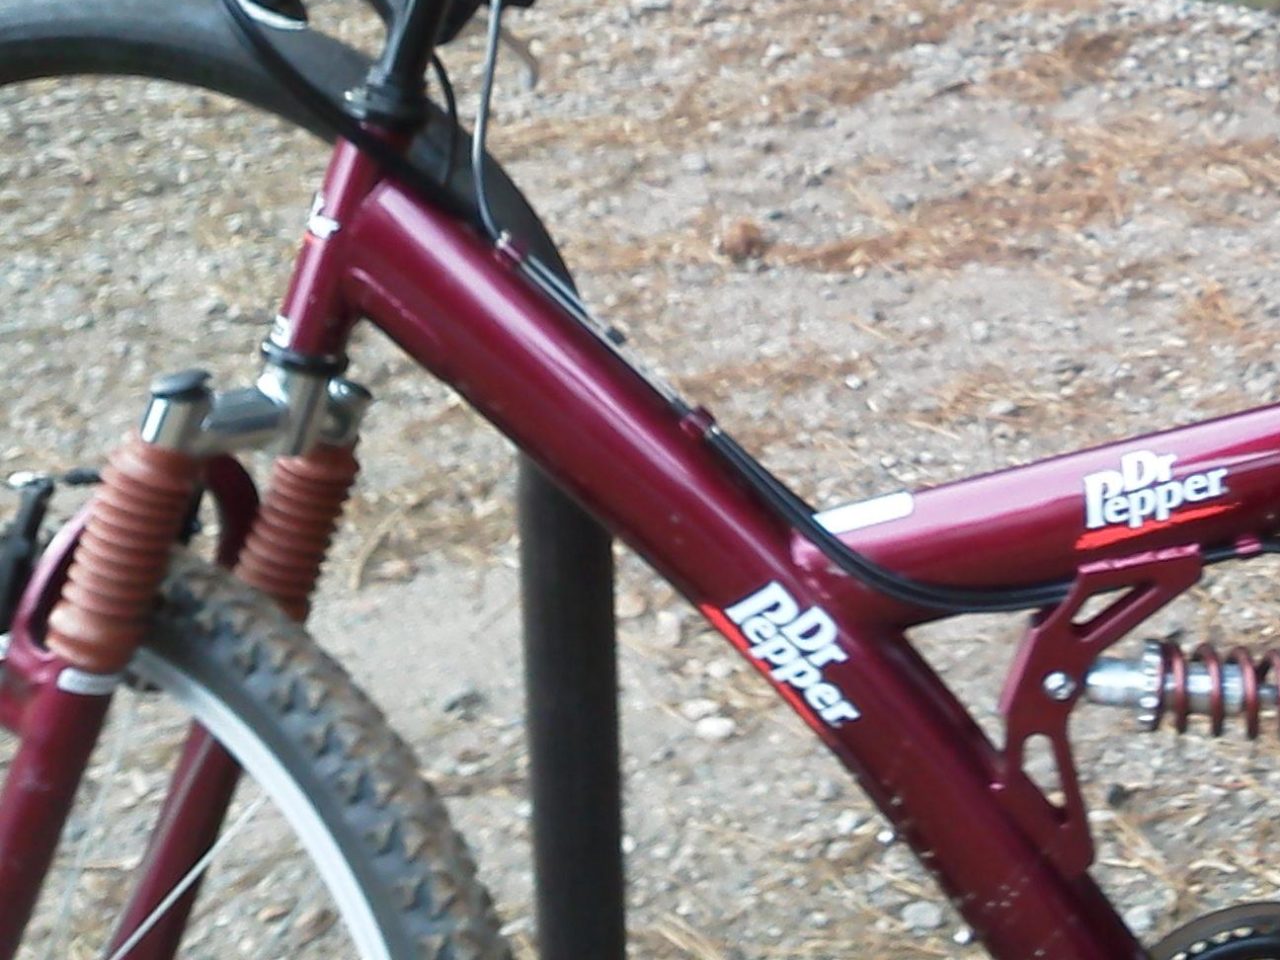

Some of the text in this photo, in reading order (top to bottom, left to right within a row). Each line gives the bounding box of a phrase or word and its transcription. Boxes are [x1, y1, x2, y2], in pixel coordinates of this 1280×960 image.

[1082, 468, 1230, 529] Pepper
[1120, 450, 1178, 490] Dr
[723, 580, 862, 725] Pepper
[779, 605, 849, 668] Dr
